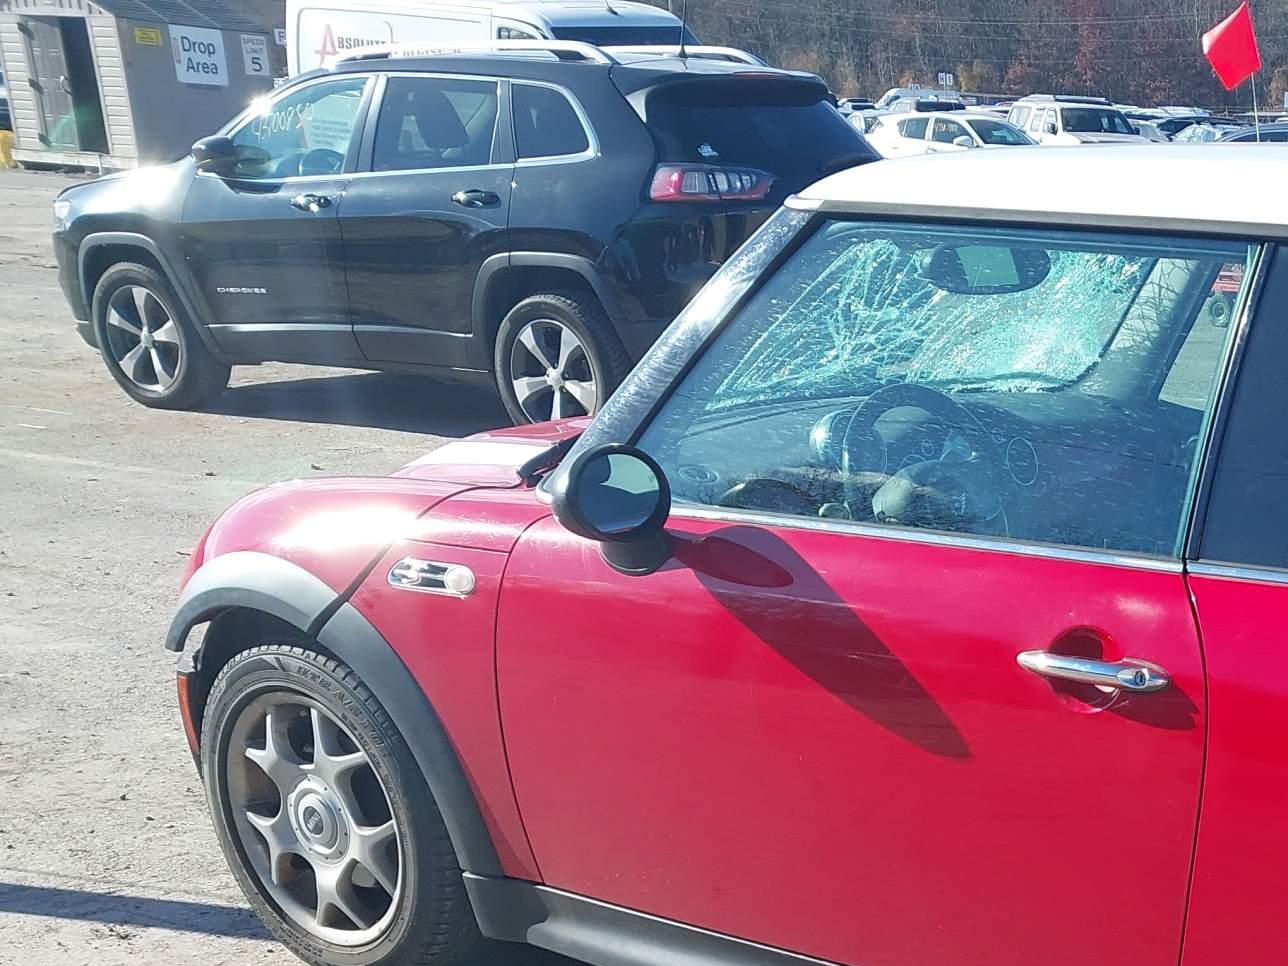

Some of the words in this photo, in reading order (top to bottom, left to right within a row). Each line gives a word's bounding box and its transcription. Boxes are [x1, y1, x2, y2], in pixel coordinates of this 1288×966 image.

[181, 36, 216, 57] Drop
[186, 57, 218, 75] Area
[251, 57, 262, 72] 5
